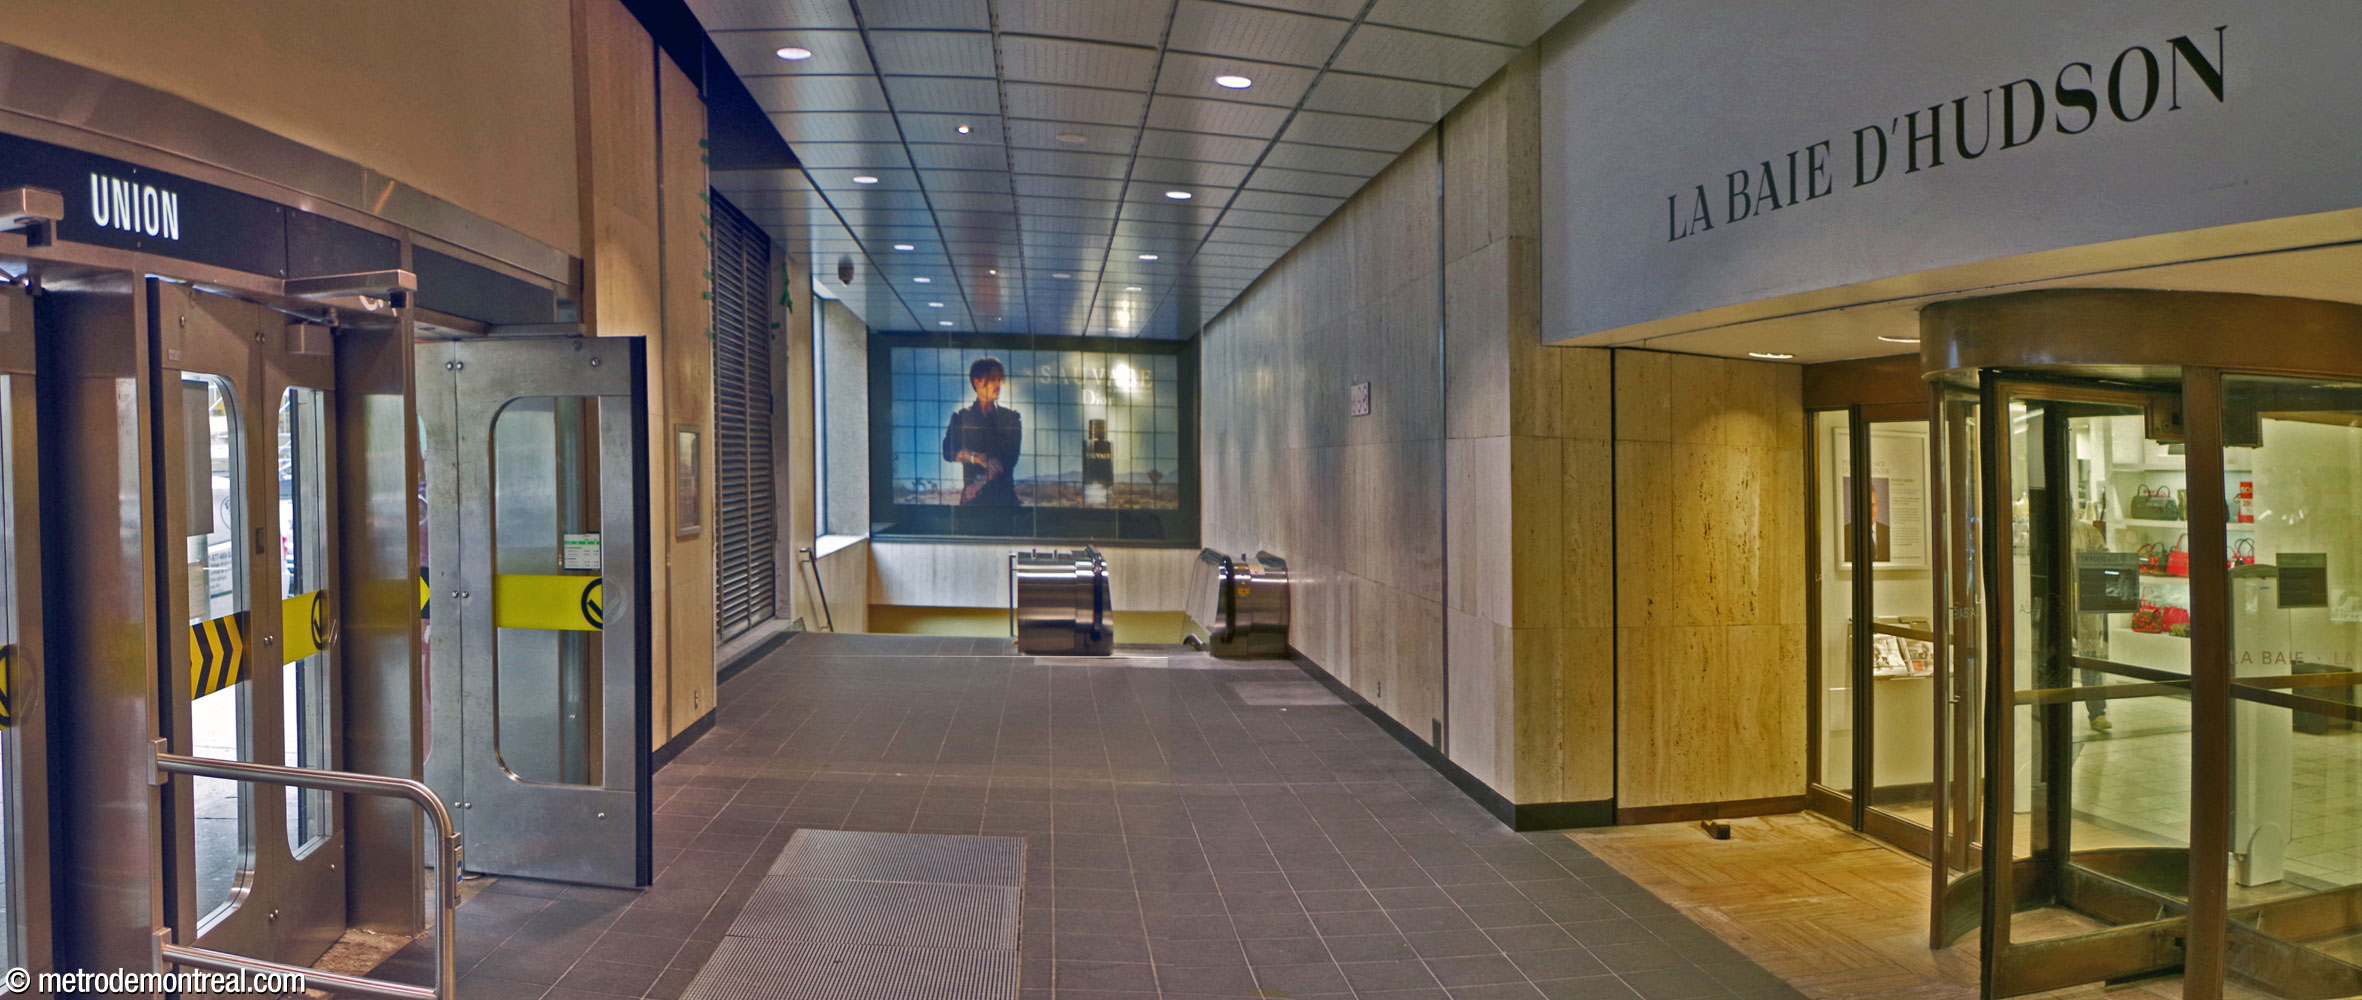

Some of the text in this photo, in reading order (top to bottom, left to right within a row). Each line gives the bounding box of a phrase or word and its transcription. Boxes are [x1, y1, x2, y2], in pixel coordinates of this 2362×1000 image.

[1667, 24, 2229, 242] LA BAIE D'HUDSON
[91, 172, 179, 241] UNION
[1041, 365, 1153, 388] SAUVE
[1083, 389, 1113, 406] Dior
[2230, 650, 2305, 665] LA BAIE
[2333, 650, 2356, 665] LA
